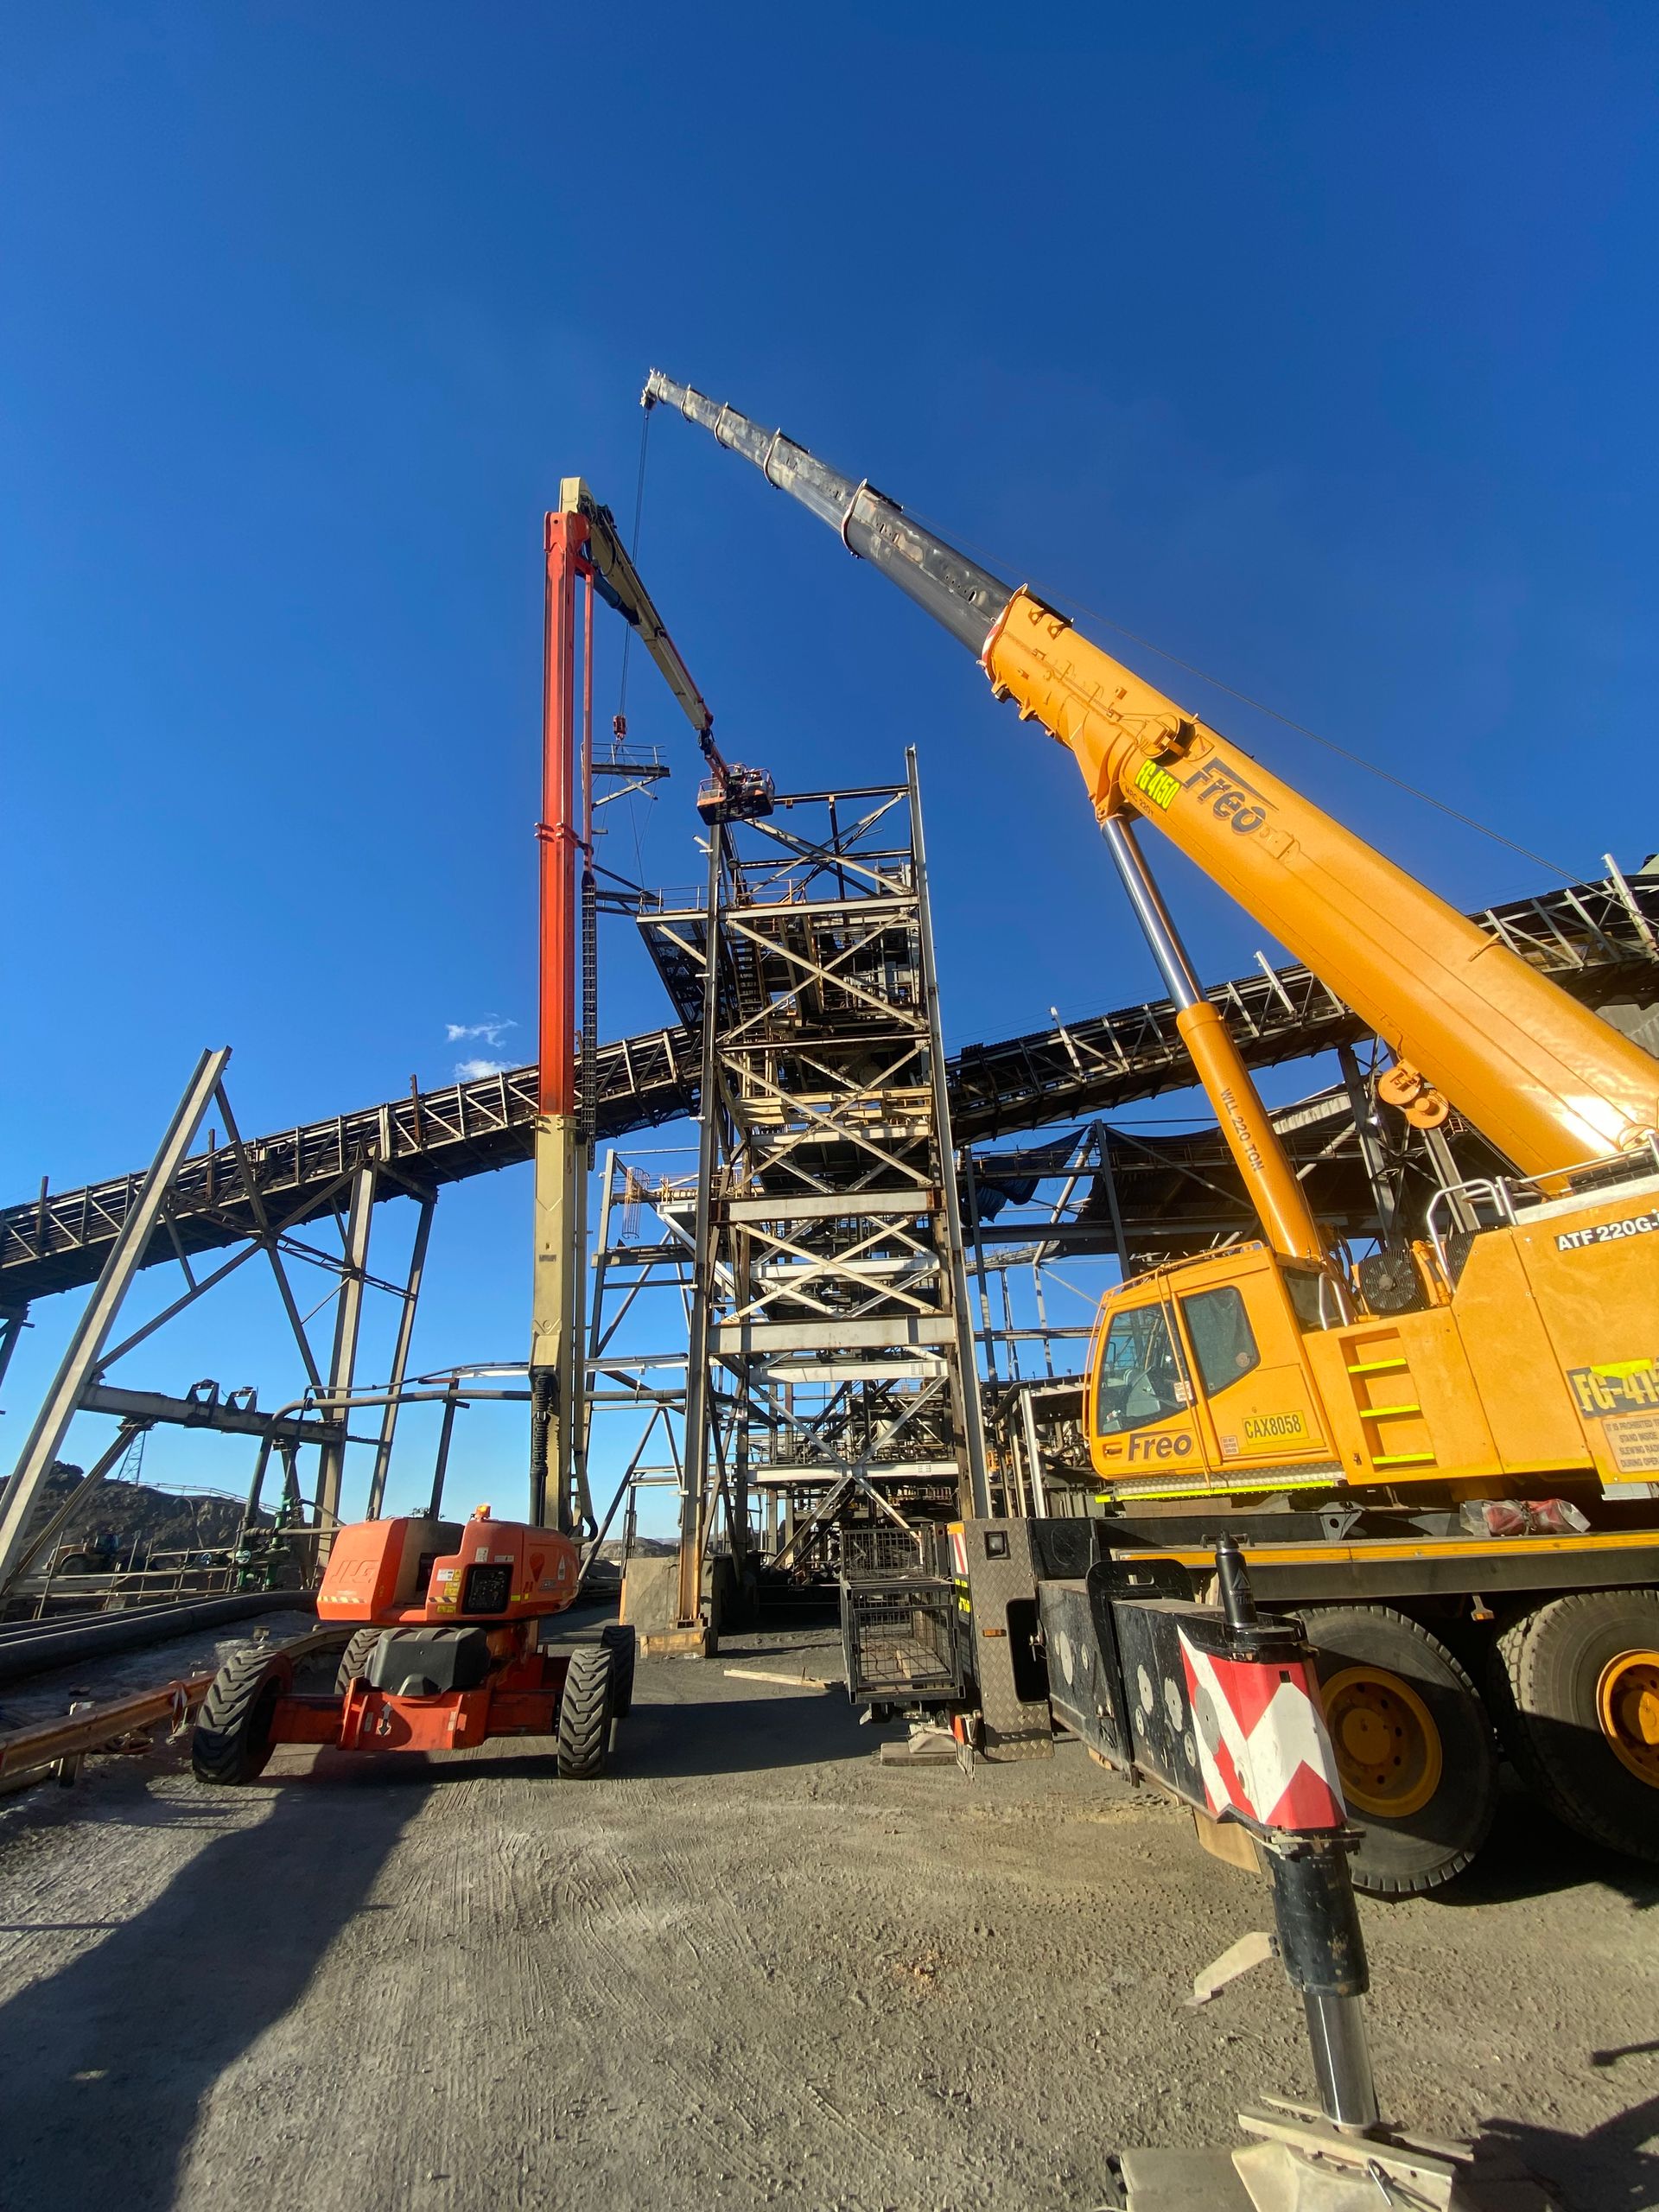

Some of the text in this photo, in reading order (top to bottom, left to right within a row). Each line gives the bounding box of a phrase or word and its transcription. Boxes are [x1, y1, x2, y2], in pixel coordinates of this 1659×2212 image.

[1181, 757, 1279, 834] Freo
[1220, 1088, 1265, 1172] WLL 220 TON
[1558, 1229, 1593, 1251] ATF
[1244, 1414, 1301, 1439] CAX8058
[1128, 1427, 1192, 1461] Freo
[329, 1560, 380, 1584] JLG
